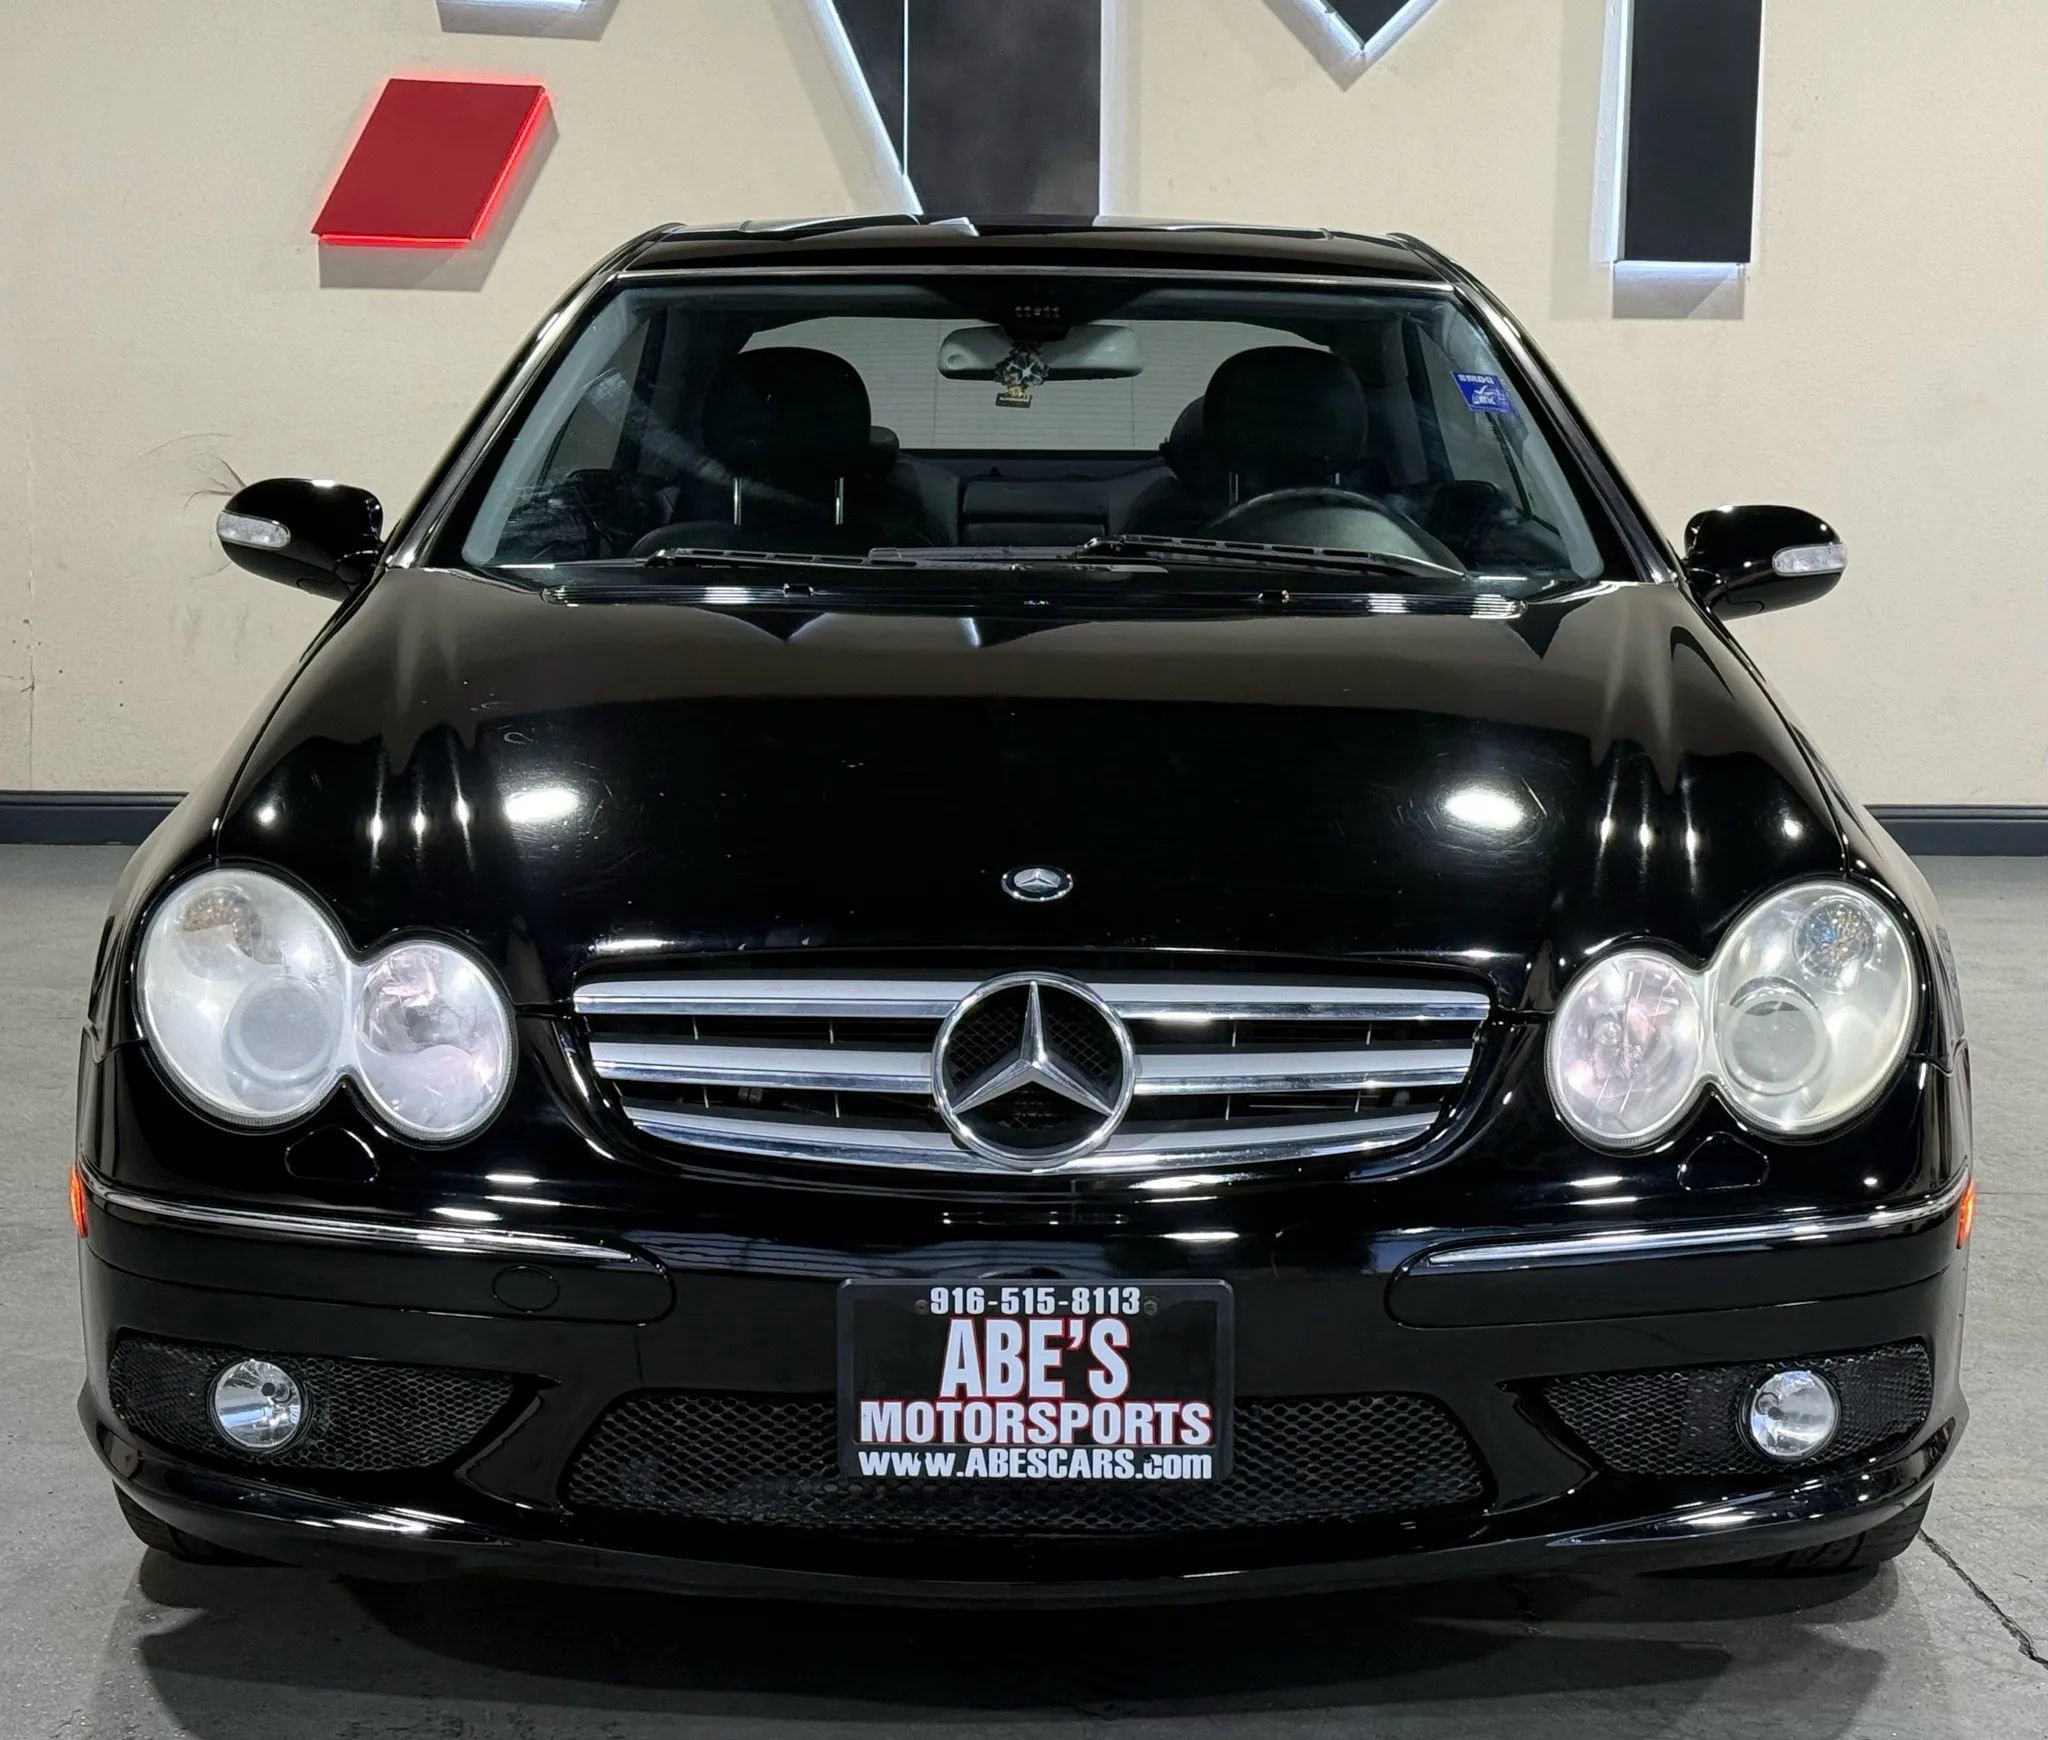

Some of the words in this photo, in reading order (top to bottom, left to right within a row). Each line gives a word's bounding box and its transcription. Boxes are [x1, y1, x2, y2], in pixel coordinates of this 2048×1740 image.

[929, 1286, 1141, 1315] 916-515-8113
[938, 1316, 1131, 1399] ABE'S
[859, 1400, 1213, 1445] MOTORSPORTS
[857, 1447, 1213, 1480] www.ABESCARS.com
